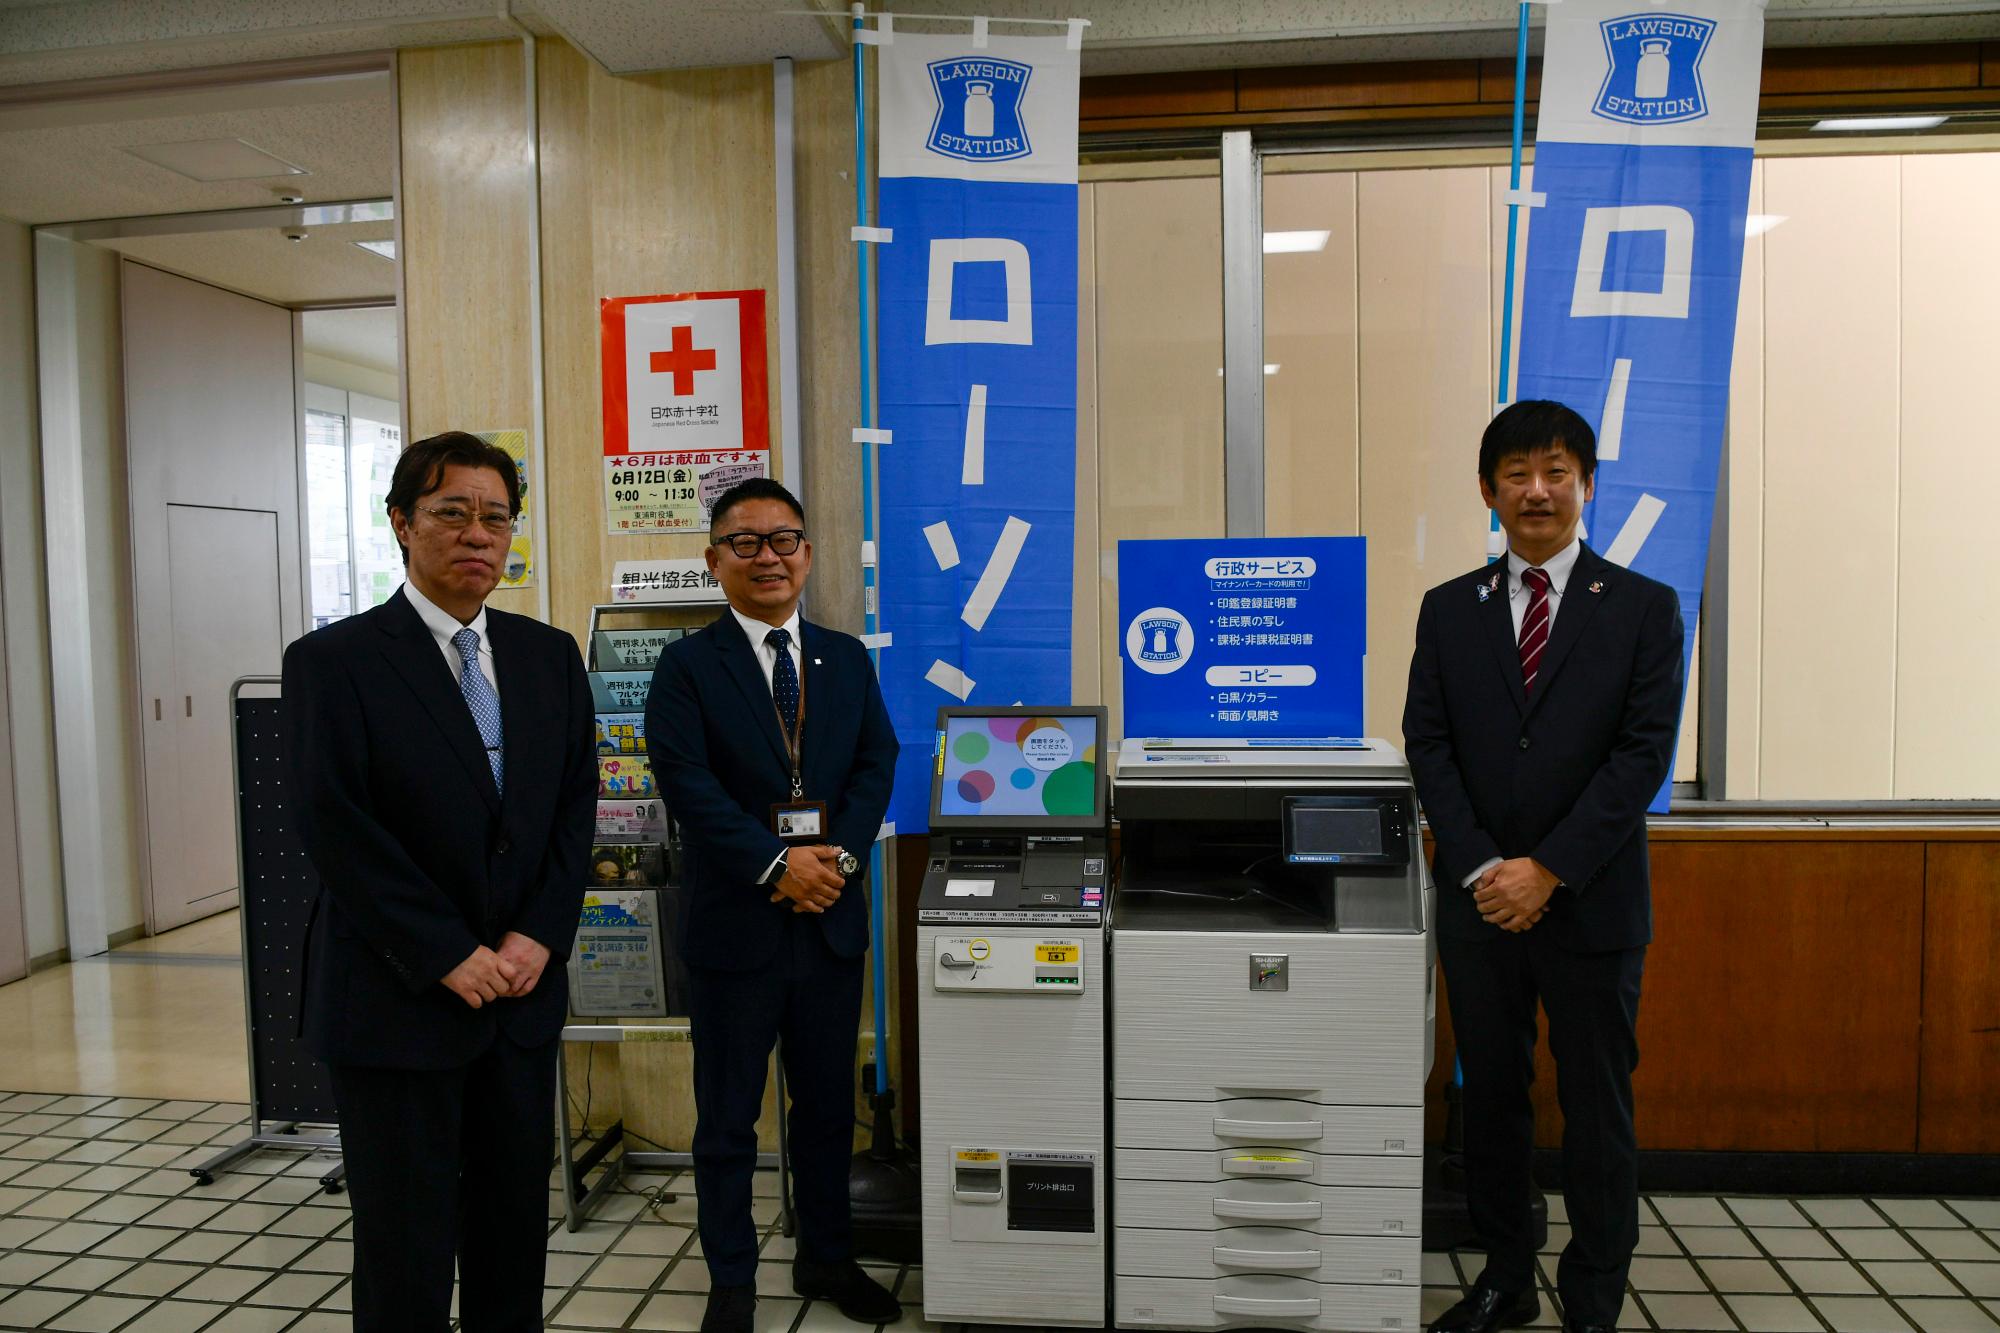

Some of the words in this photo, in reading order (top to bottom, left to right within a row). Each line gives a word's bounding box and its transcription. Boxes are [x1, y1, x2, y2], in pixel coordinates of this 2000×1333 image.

[1611, 20, 1706, 42] LAWSON
[937, 63, 1023, 84] LAWSON
[1606, 95, 1695, 117] STATION
[938, 131, 1020, 155] STATION
[651, 404, 719, 419] 日本赤十字社
[615, 489, 639, 501] 9:00
[664, 487, 695, 500] 11:30
[634, 510, 674, 519] 東浦町役場
[1215, 560, 1306, 577] 行政サービス
[1214, 580, 1307, 589] マイナンバーカードの利用で!
[1142, 619, 1178, 630] LAWSON
[1142, 651, 1178, 661] STATION
[1238, 668, 1283, 683] コピー
[1026, 1182, 1076, 1192] プリント排出口
